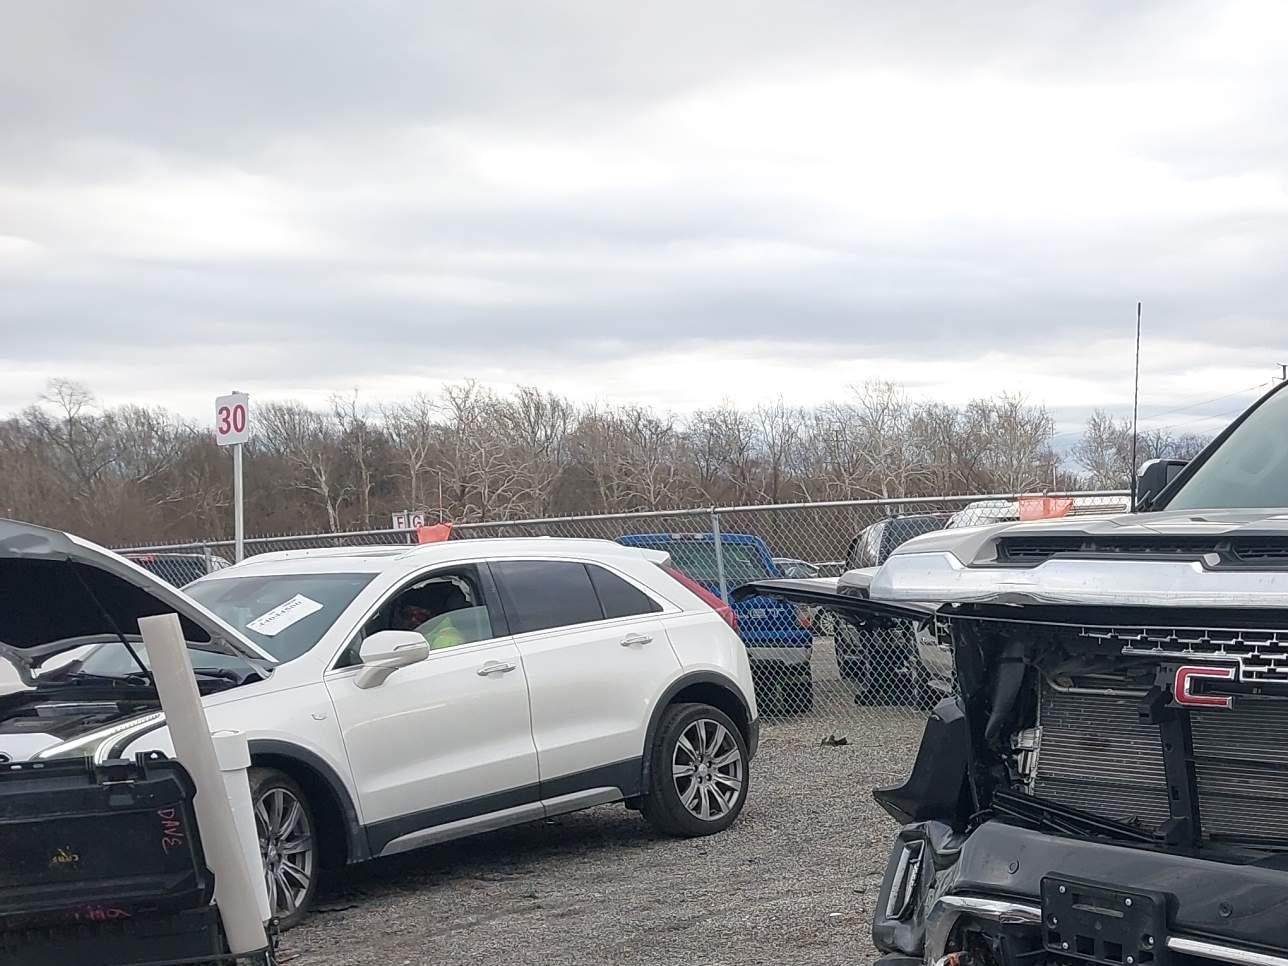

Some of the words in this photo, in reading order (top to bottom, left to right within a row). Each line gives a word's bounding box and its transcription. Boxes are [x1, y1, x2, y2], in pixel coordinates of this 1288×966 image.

[218, 404, 245, 435] 30
[397, 516, 403, 528] F
[157, 808, 184, 856] DAVE
